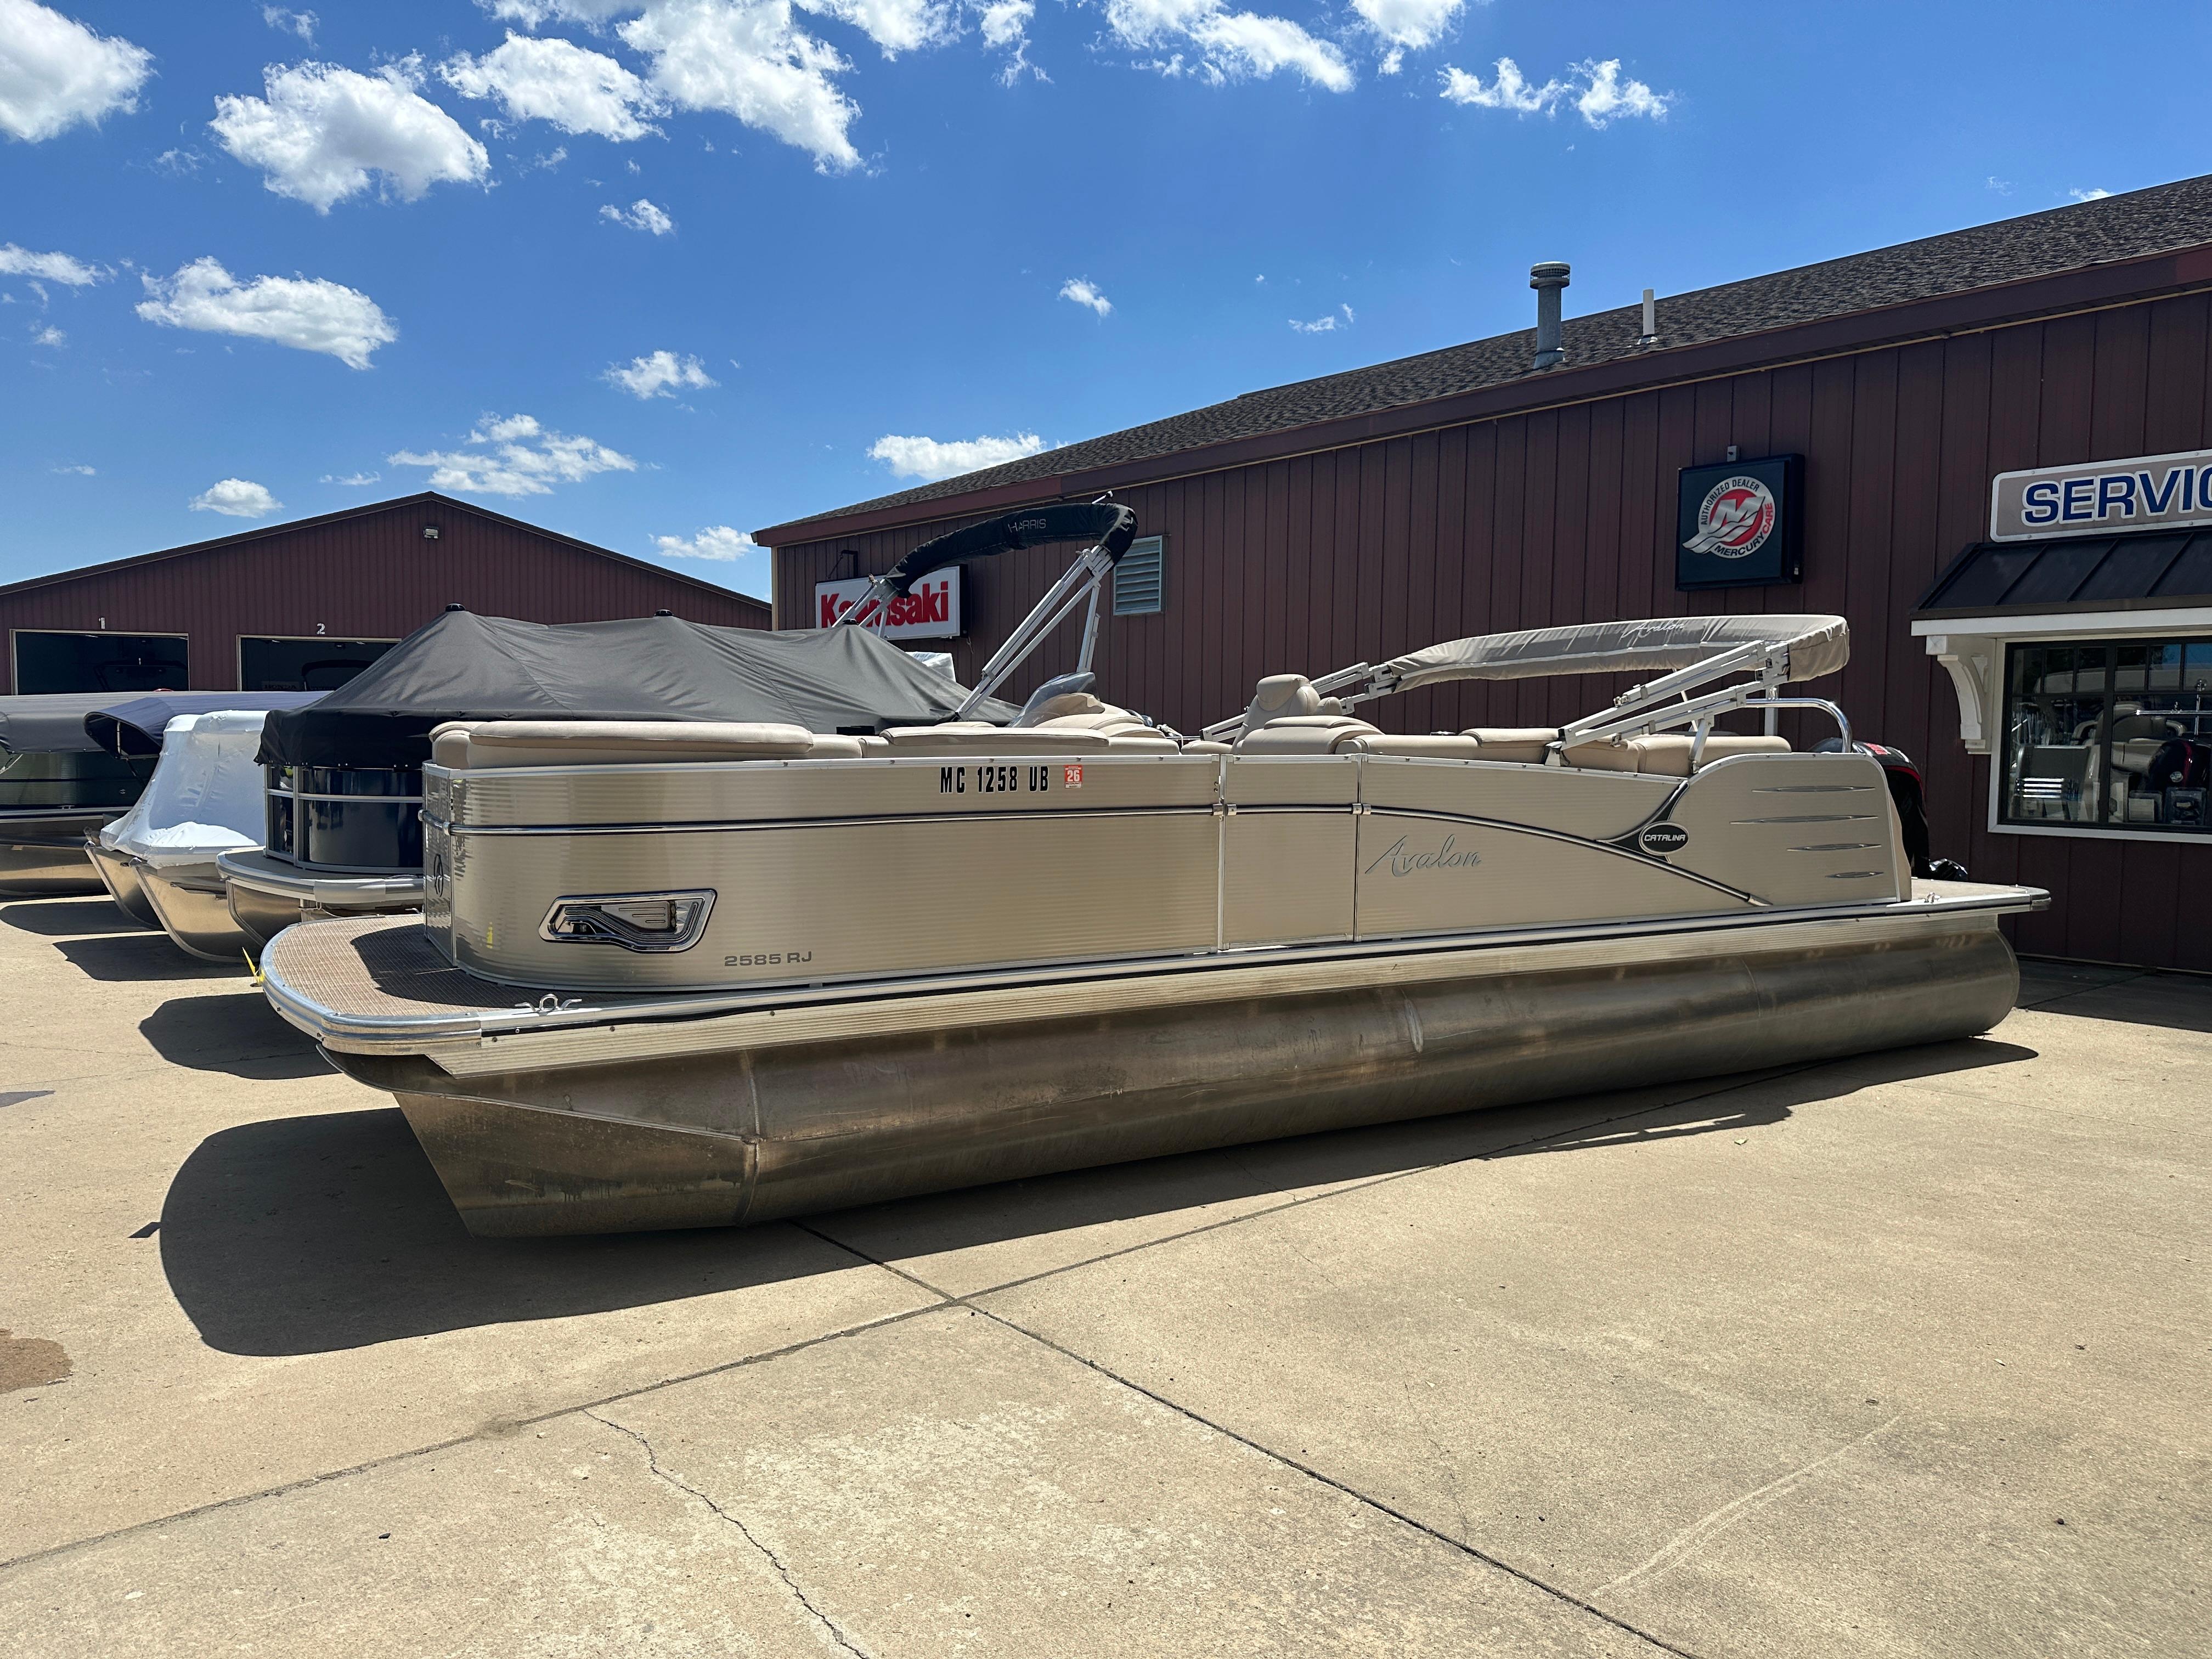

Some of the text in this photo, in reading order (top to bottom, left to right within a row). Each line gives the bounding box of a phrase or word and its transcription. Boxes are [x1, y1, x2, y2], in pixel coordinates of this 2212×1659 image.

[1701, 478, 1759, 525] AUTHORIZED DEALER
[1008, 518, 1046, 533] HARRIS
[98, 617, 105, 629] 1
[317, 623, 325, 634] 2
[940, 766, 1049, 793] MC 1258 UB
[1067, 770, 1080, 782] 26
[1365, 833, 1482, 877] Avalon
[724, 951, 812, 967] 2585 RJ
